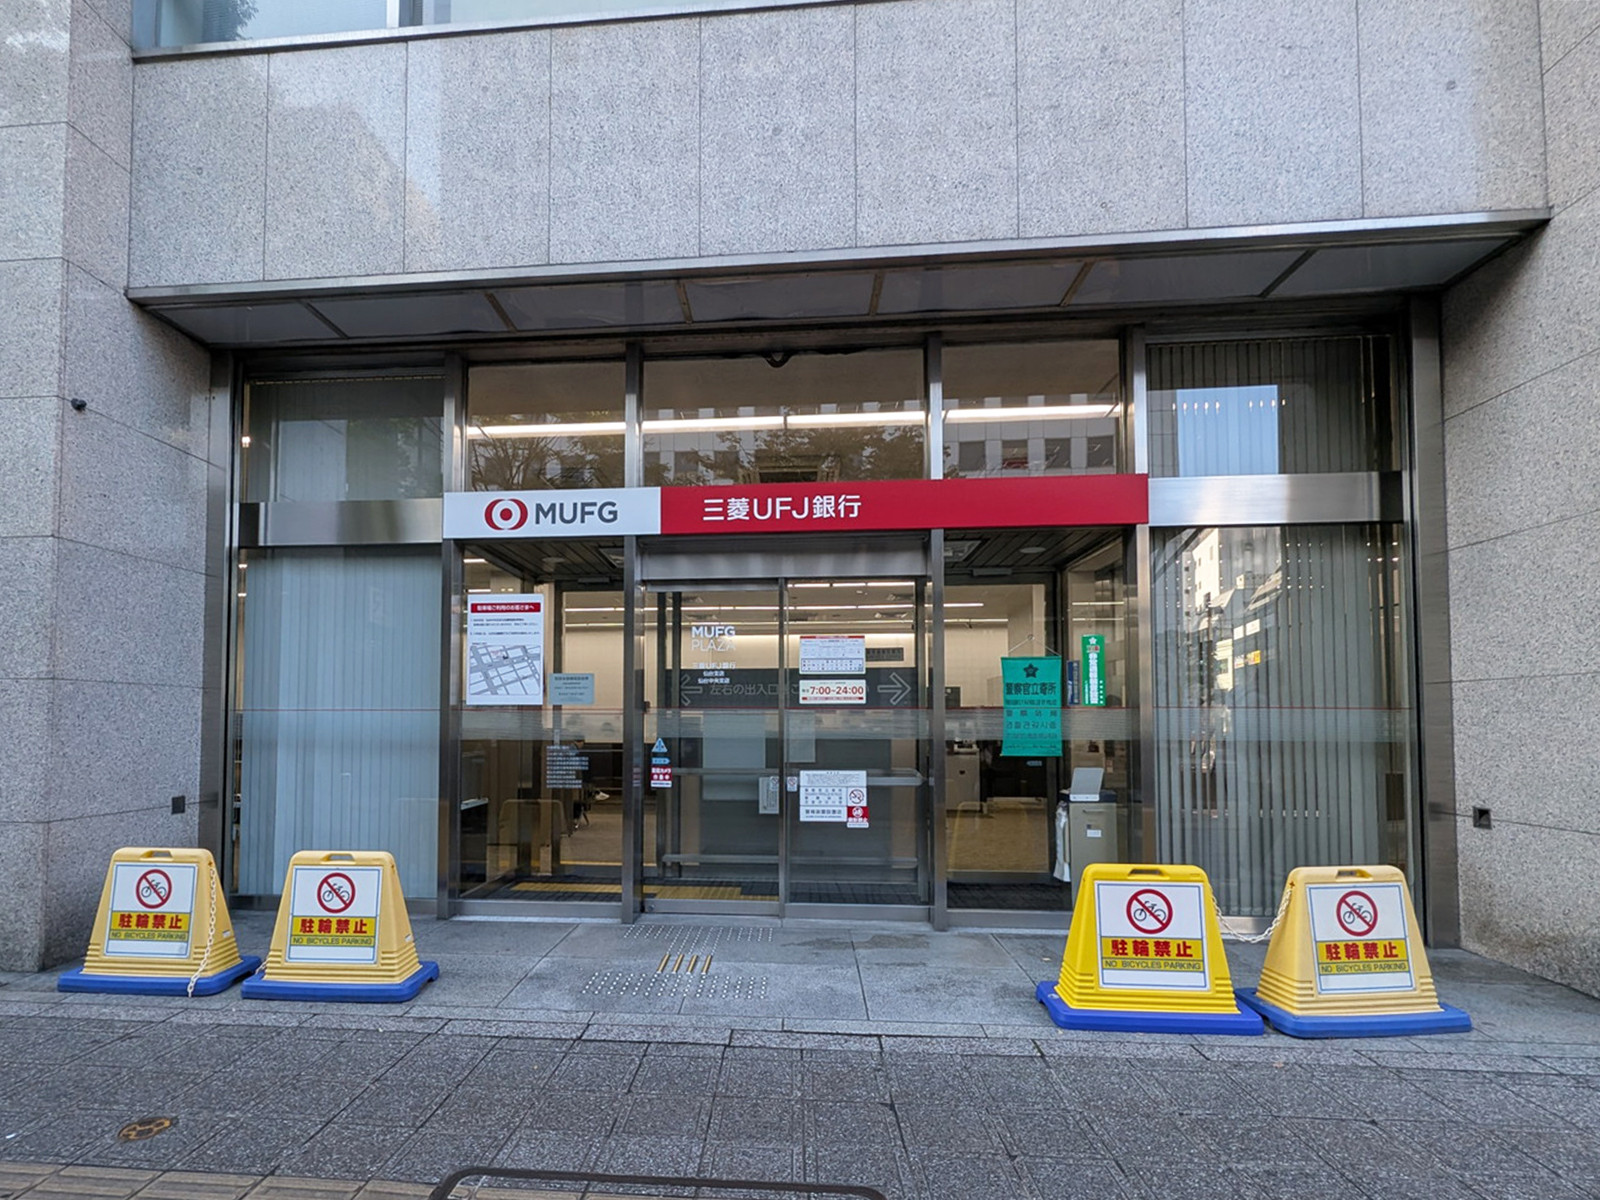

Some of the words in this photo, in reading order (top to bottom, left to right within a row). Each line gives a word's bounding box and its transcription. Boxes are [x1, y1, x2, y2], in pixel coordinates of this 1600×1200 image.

[534, 501, 618, 525] MUFG
[702, 494, 862, 521] 三菱UFJ銀行
[691, 626, 736, 638] MUFG
[691, 638, 736, 651] PLAZA
[118, 913, 183, 929] 駐輪禁止
[299, 918, 368, 934] 駐輪禁止
[306, 937, 340, 945] BICYCLES
[341, 937, 372, 945] PARKING
[1111, 939, 1194, 958] 駐輪禁止
[1325, 941, 1399, 961] 駐輪禁止
[1104, 960, 1118, 968] NO
[1121, 960, 1162, 969] BICYCLES
[1163, 961, 1202, 970] PARKING
[1321, 965, 1333, 973] NO
[1335, 963, 1372, 972] BICYCLES
[1373, 962, 1407, 970] PARKING
